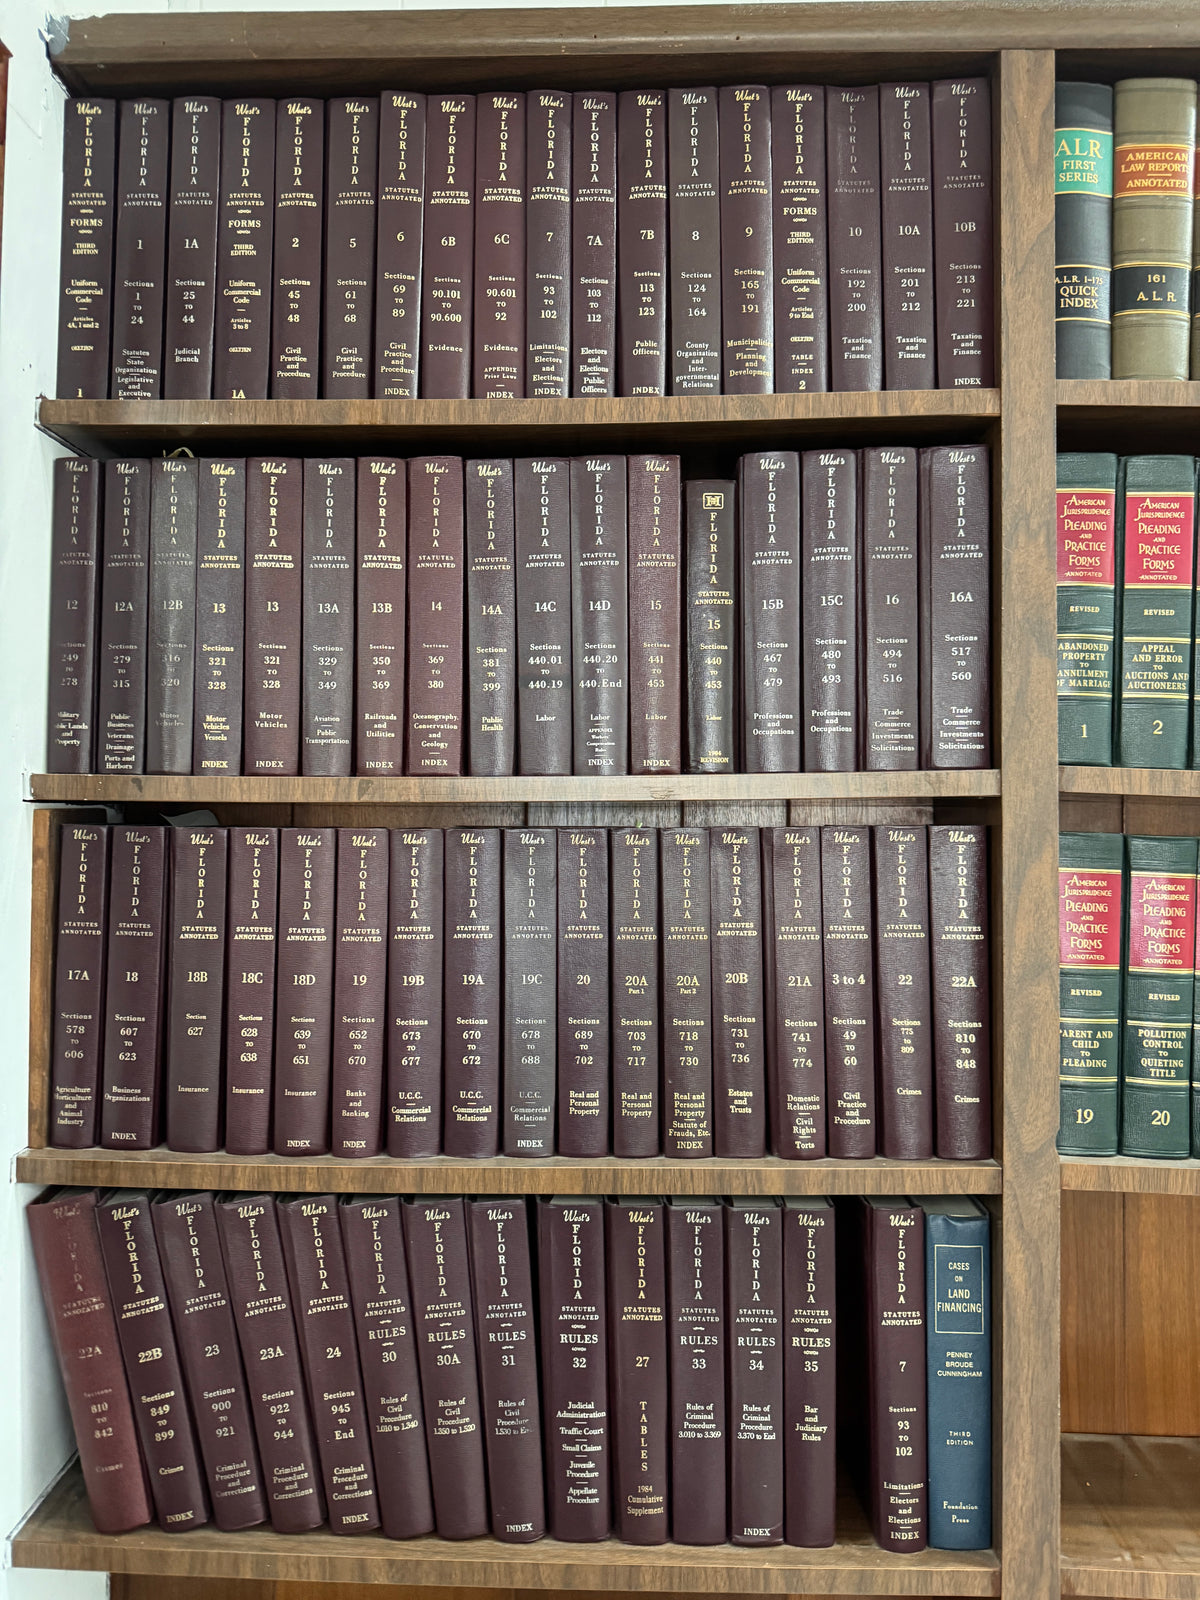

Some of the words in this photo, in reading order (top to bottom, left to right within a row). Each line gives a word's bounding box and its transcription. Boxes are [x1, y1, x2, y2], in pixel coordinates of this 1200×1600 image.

[547, 109, 555, 179] FLORIDA
[1055, 138, 1103, 159] ALR
[1126, 152, 1189, 161] AMERICAN
[1063, 161, 1096, 171] FIRST
[1059, 173, 1099, 184] SERIES
[1126, 178, 1188, 189] ANNOTATED
[533, 186, 569, 195] STATUTES
[531, 194, 570, 202] ANNOTATED
[783, 207, 817, 215] FORMS
[70, 218, 103, 226] FORMS
[228, 220, 261, 228] FORMS
[955, 222, 976, 232] 10B
[640, 230, 654, 240] 7B
[745, 227, 753, 237] 9
[850, 227, 862, 236] 10
[899, 225, 920, 235] 10A
[397, 231, 405, 241] 6
[494, 234, 510, 244] 6C
[546, 232, 553, 242] 7
[587, 235, 603, 246] 7A
[692, 230, 700, 241] 8
[137, 239, 143, 249] 1
[184, 238, 199, 249] 1A
[292, 237, 299, 247] 2
[349, 238, 356, 248] 5
[441, 236, 456, 246] 6B
[384, 272, 415, 280] Sections
[1148, 274, 1166, 283] 161
[901, 278, 919, 287] 201
[288, 290, 300, 299] 45
[432, 290, 461, 299] 90.101
[1060, 286, 1099, 297] QUICK
[902, 302, 920, 311] 212
[1060, 298, 1099, 309] INDEX
[287, 314, 300, 322] 48
[431, 313, 462, 323] 90.600
[429, 344, 463, 353] Evidence
[484, 344, 518, 352] Evidence
[954, 377, 981, 386] INDEX
[632, 386, 660, 394] INDEX
[378, 476, 387, 548] FLORIDA
[1069, 554, 1100, 567] FORMS
[1143, 558, 1175, 570] FORMS
[821, 595, 843, 606] 15C
[886, 594, 899, 605] 16
[950, 591, 974, 602] 16A
[115, 601, 134, 611] 12A
[213, 603, 226, 613] 13
[267, 601, 279, 612] 13
[318, 603, 339, 613] 13A
[372, 603, 392, 613] 13B
[432, 601, 442, 611] 14
[482, 604, 504, 615] 14A
[535, 601, 556, 612] 14C
[589, 600, 611, 611] 14D
[651, 600, 662, 610] 15
[762, 599, 784, 610] 15B
[1070, 605, 1100, 613] REVISED
[707, 619, 721, 630] 15
[951, 647, 971, 656] 517
[1141, 644, 1175, 653] APPEAL
[373, 656, 391, 665] 350
[528, 655, 562, 665] 440.01
[1063, 652, 1106, 661] PROPERTY
[1132, 654, 1152, 662] AND
[1155, 654, 1183, 663] ERROR
[951, 672, 972, 680] 560
[372, 681, 390, 689] 369
[528, 680, 563, 689] 440.19
[1127, 681, 1187, 690] AUCTIONEERS
[536, 713, 556, 721] Labor
[753, 712, 794, 721] Professions
[1081, 724, 1088, 738] 1
[1153, 720, 1163, 734] 2
[1070, 937, 1102, 950] FORMS
[68, 970, 90, 980] 17A
[126, 971, 138, 982] 18
[187, 971, 208, 982] 18B
[242, 972, 263, 984] 18C
[293, 974, 316, 985] 18D
[463, 974, 485, 985] 19A
[522, 974, 542, 985] 19C
[577, 974, 591, 985] 20
[725, 973, 748, 984] 20B
[898, 974, 913, 985] 22
[353, 975, 367, 986] 19
[403, 975, 425, 986] 19B
[625, 975, 648, 986] 20A
[676, 975, 700, 986] 20A
[788, 975, 812, 987] 21A
[951, 976, 977, 987] 22A
[1148, 993, 1180, 1001] REVISED
[187, 1027, 203, 1036] 627
[402, 1031, 421, 1040] 673
[1138, 1029, 1187, 1039] POLLUTION
[1072, 1040, 1099, 1048] CHILD
[1143, 1039, 1184, 1049] CONTROL
[402, 1056, 421, 1066] 677
[1063, 1058, 1107, 1068] PLEADING
[1141, 1058, 1184, 1067] QUIETING
[1149, 1068, 1176, 1077] TITLE
[954, 1095, 980, 1103] Crimes
[729, 1105, 752, 1114] Trusts
[1076, 1108, 1094, 1124] 19
[1151, 1110, 1170, 1126] 20
[948, 1262, 970, 1271] CASES
[948, 1288, 970, 1299] LAND
[937, 1302, 981, 1313] FINANCING
[560, 1334, 598, 1344] RULES
[680, 1336, 718, 1345] RULES
[138, 1347, 163, 1363] 22B
[205, 1344, 220, 1357] 23
[260, 1346, 284, 1360] 23A
[326, 1347, 341, 1359] 24
[382, 1351, 397, 1363] 30
[437, 1353, 461, 1366] 30A
[502, 1355, 515, 1366] 31
[636, 1356, 650, 1367] 27
[573, 1357, 586, 1368] 32
[692, 1358, 706, 1369] 33
[749, 1359, 764, 1370] 34
[804, 1361, 819, 1372] 35
[899, 1361, 906, 1372] 7
[331, 1403, 351, 1414] 945
[639, 1401, 648, 1471] TABLES
[638, 1485, 653, 1493] 1984
[744, 1528, 771, 1536] INDEX
